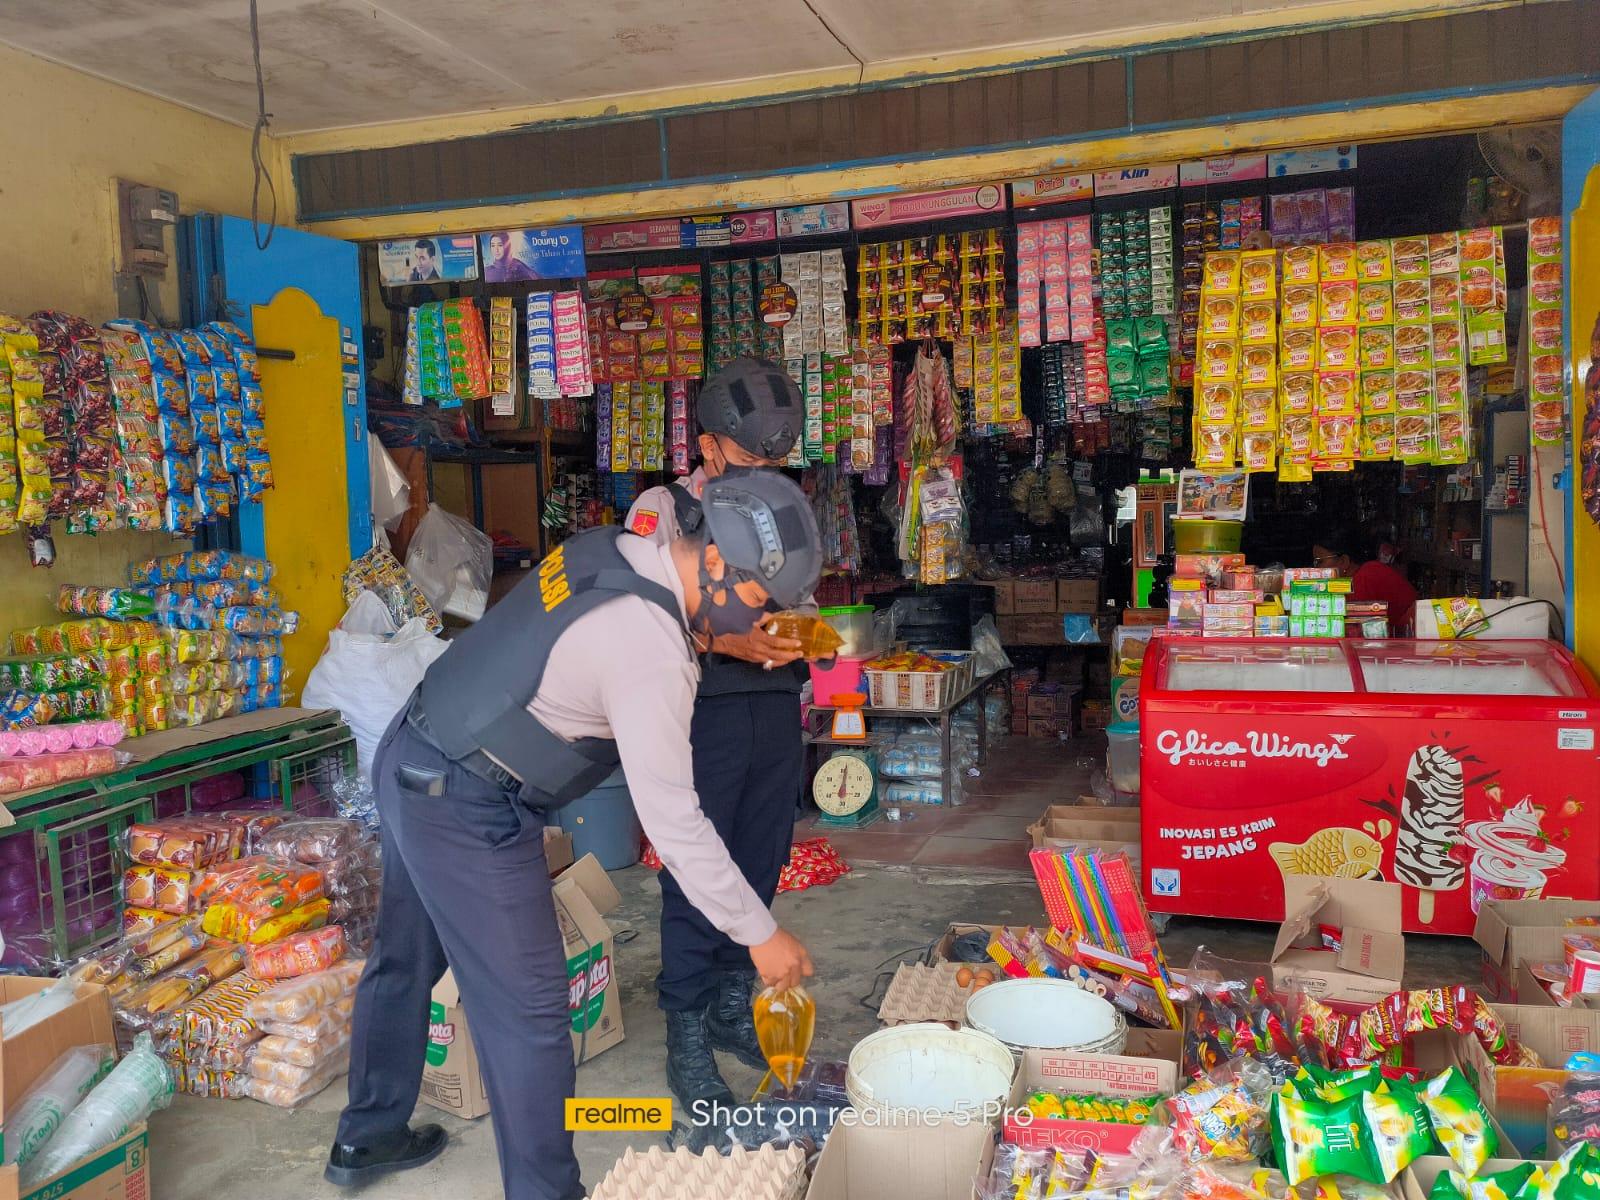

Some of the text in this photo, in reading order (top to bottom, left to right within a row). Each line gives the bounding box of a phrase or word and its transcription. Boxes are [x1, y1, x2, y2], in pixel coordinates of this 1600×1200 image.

[929, 195, 974, 209] UNGGULAN
[532, 236, 558, 248] Downy
[538, 545, 571, 613] POLISI
[1157, 730, 1348, 767] Glico Wings
[1189, 759, 1246, 767] おいしさと健康
[1160, 817, 1276, 839] INOVASI ES KRIM
[1182, 838, 1257, 860] JEPANG
[1008, 1127, 1101, 1151] TEKO
[131, 1151, 140, 1168] 8
